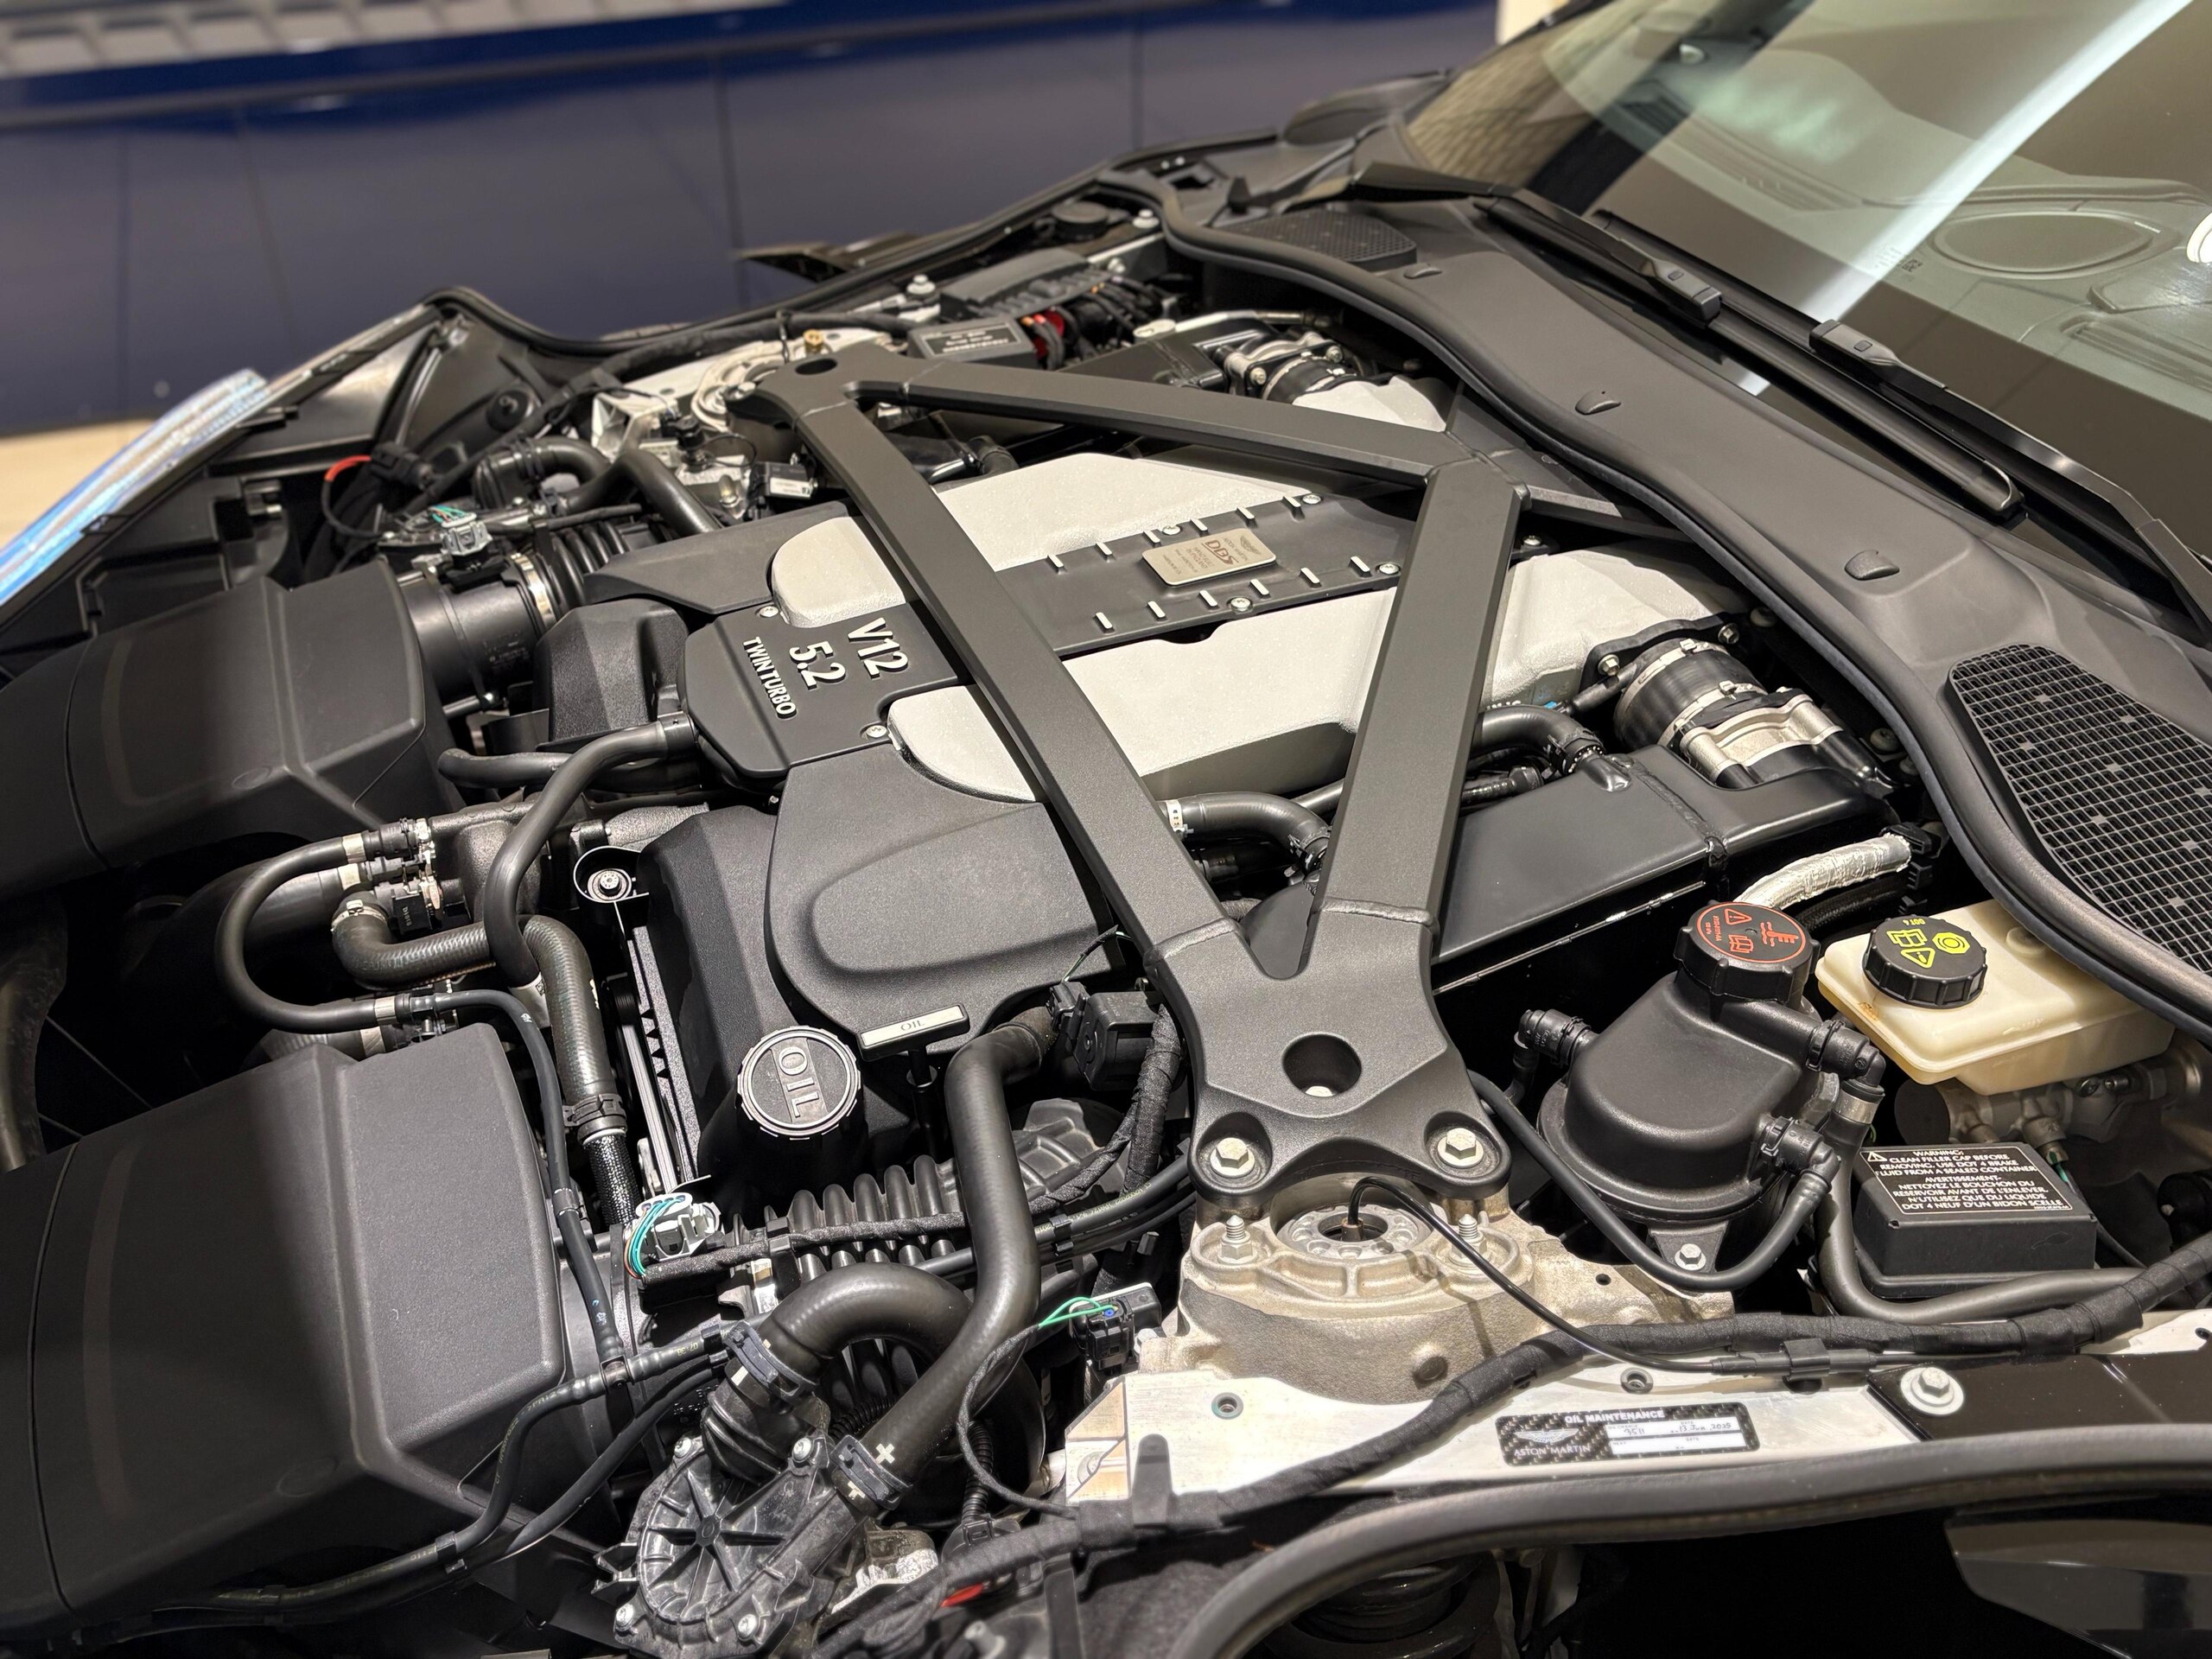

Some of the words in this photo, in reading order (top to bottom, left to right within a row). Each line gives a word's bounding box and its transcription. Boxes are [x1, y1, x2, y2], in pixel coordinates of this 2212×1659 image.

[1202, 539, 1239, 565] DBS
[848, 617, 908, 677] V12
[789, 640, 846, 689] 5.2
[900, 1020, 925, 1031] OIL
[779, 1046, 819, 1118] OIL
[1564, 1414, 1585, 1424] OIL
[1585, 1410, 1665, 1423] MAINTENANCE
[1514, 1447, 1547, 1457] ASTON
[1550, 1445, 1591, 1454] MARTIN
